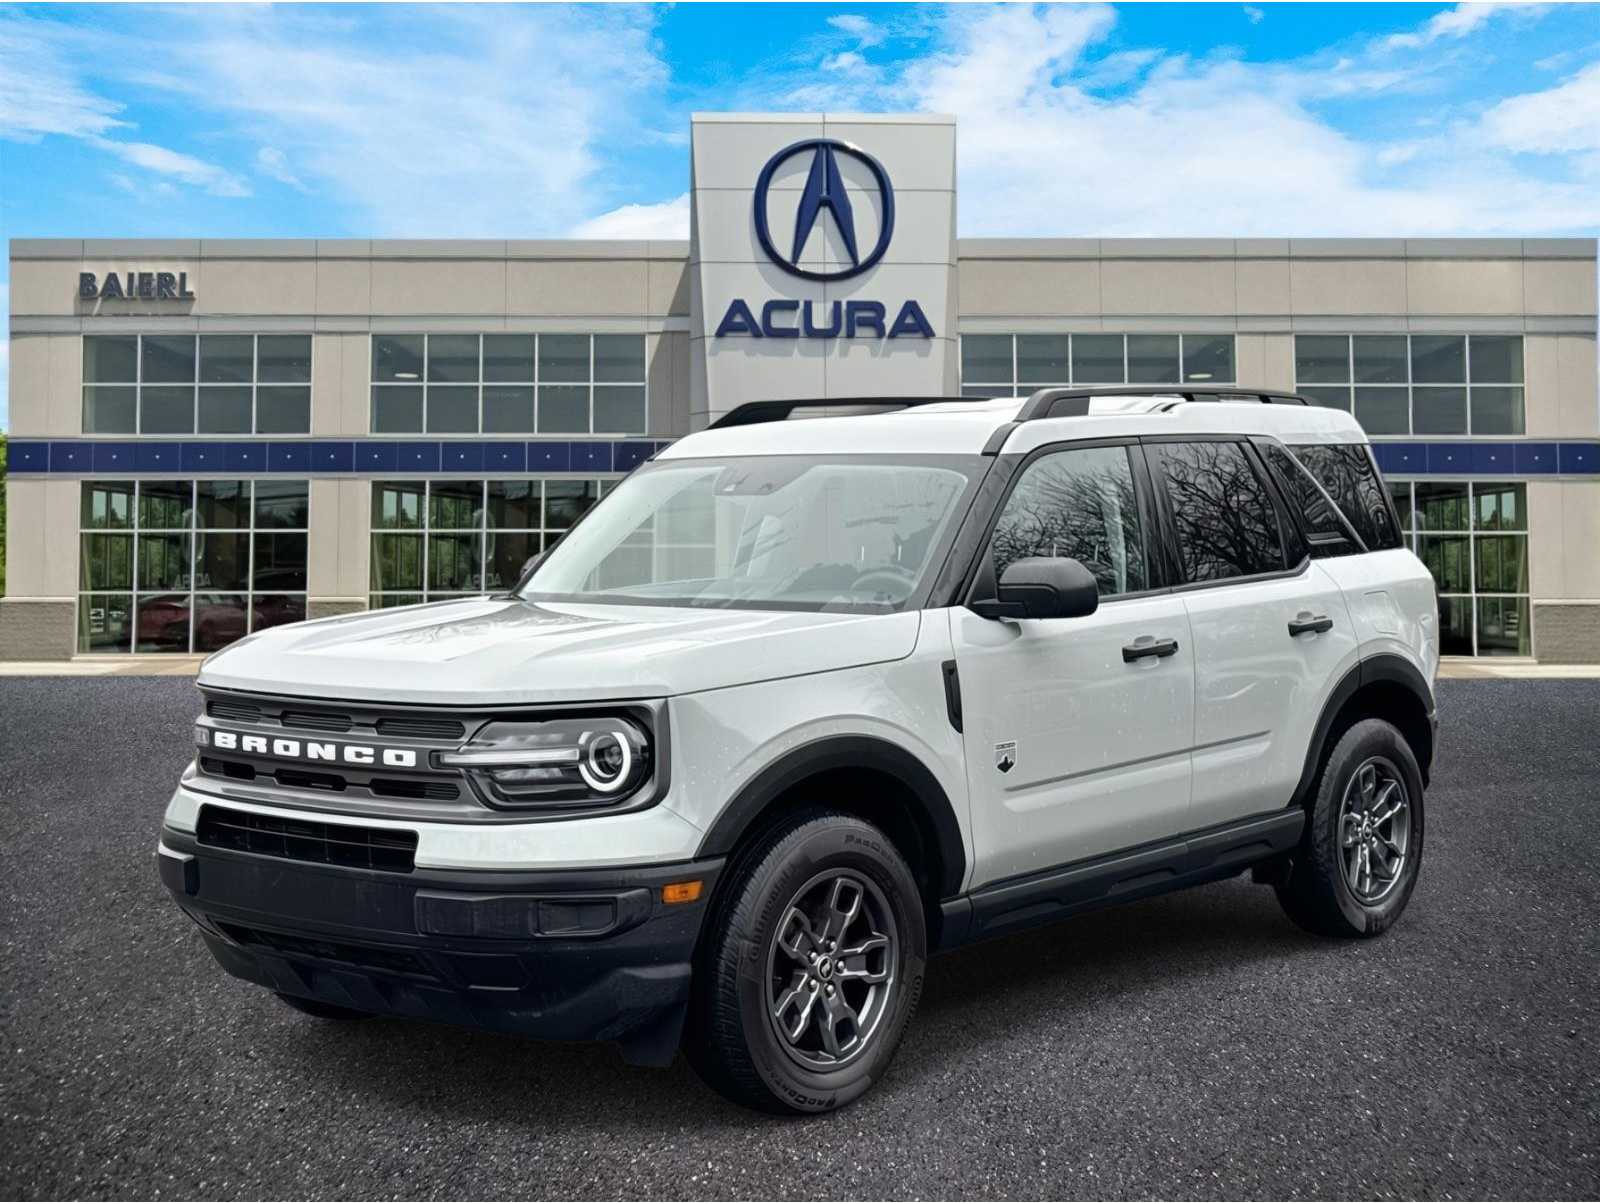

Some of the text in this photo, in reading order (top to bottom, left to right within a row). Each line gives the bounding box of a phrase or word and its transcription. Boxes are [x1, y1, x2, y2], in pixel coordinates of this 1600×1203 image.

[79, 272, 196, 301] BAIERL
[715, 299, 936, 338] ACURA
[214, 731, 417, 767] BRONCO
